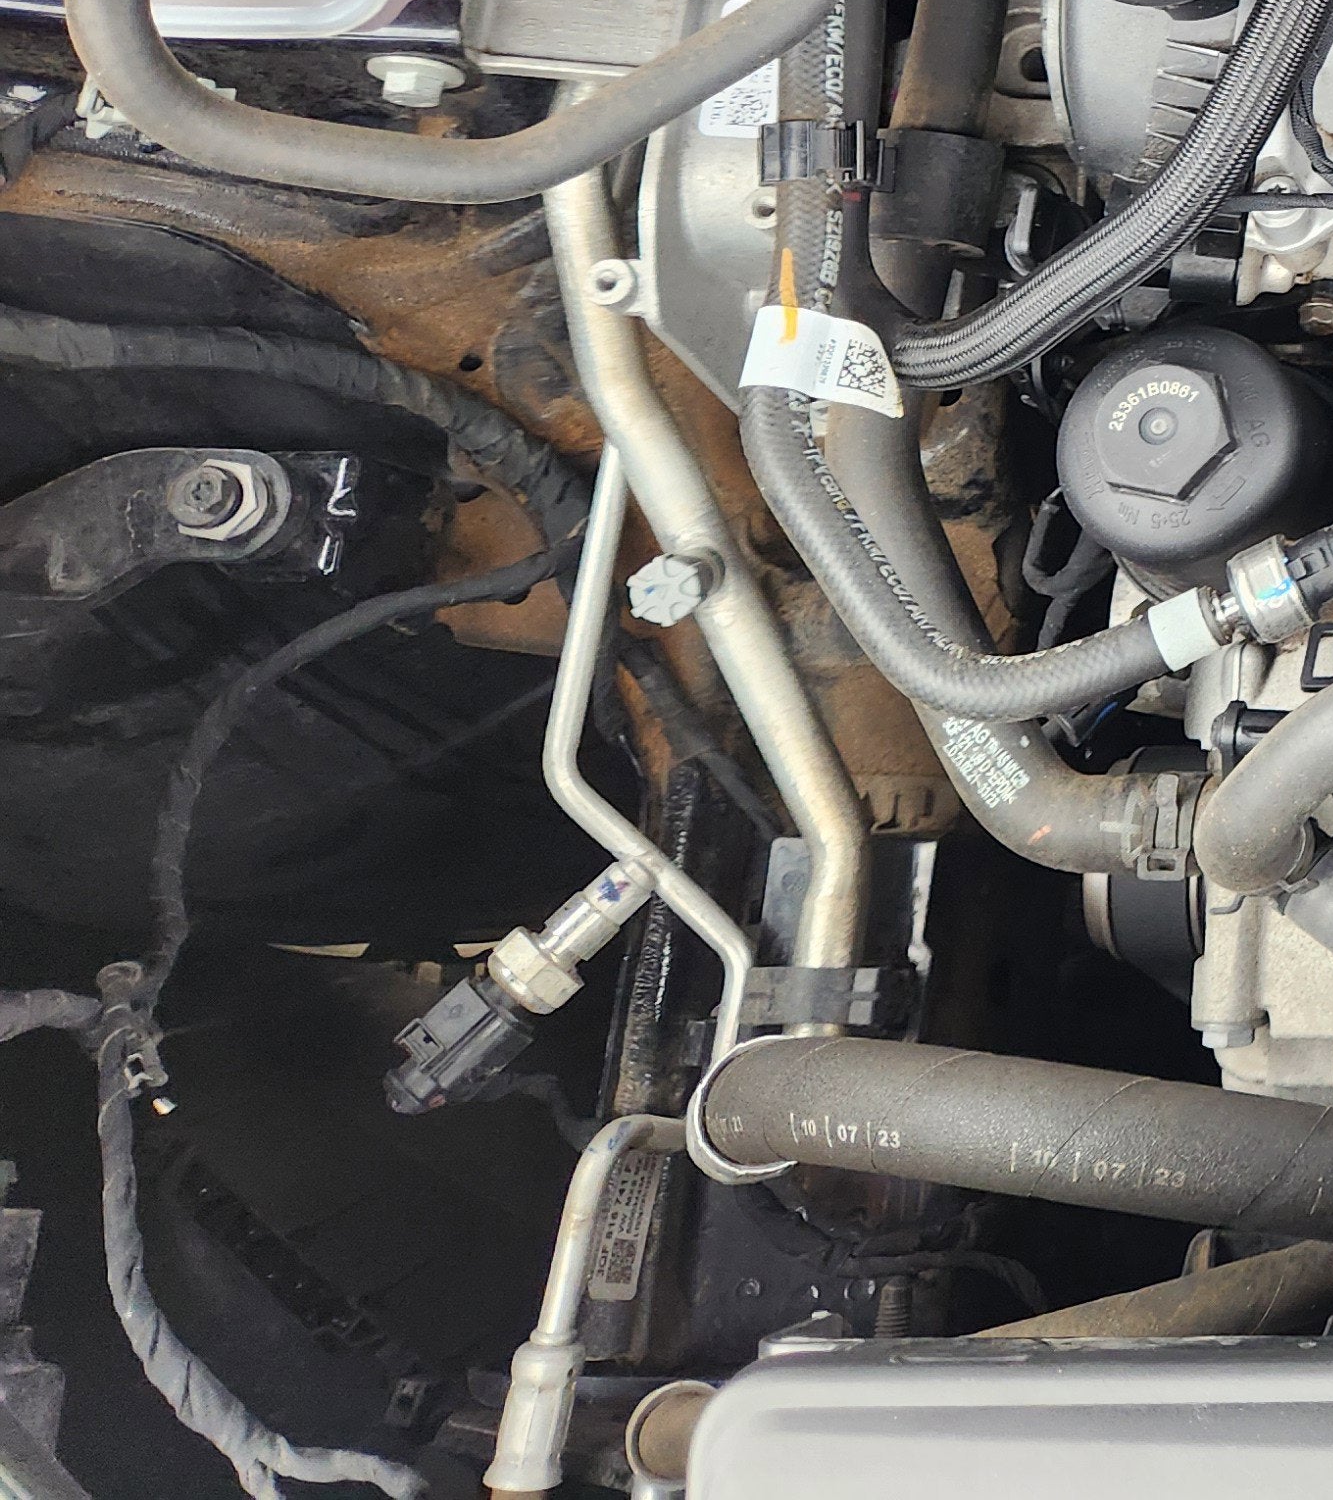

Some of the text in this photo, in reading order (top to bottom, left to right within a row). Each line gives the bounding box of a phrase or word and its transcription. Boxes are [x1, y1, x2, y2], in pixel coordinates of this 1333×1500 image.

[838, 1124, 857, 1142] 07
[879, 1130, 900, 1148] 23
[1094, 1159, 1126, 1180] 07
